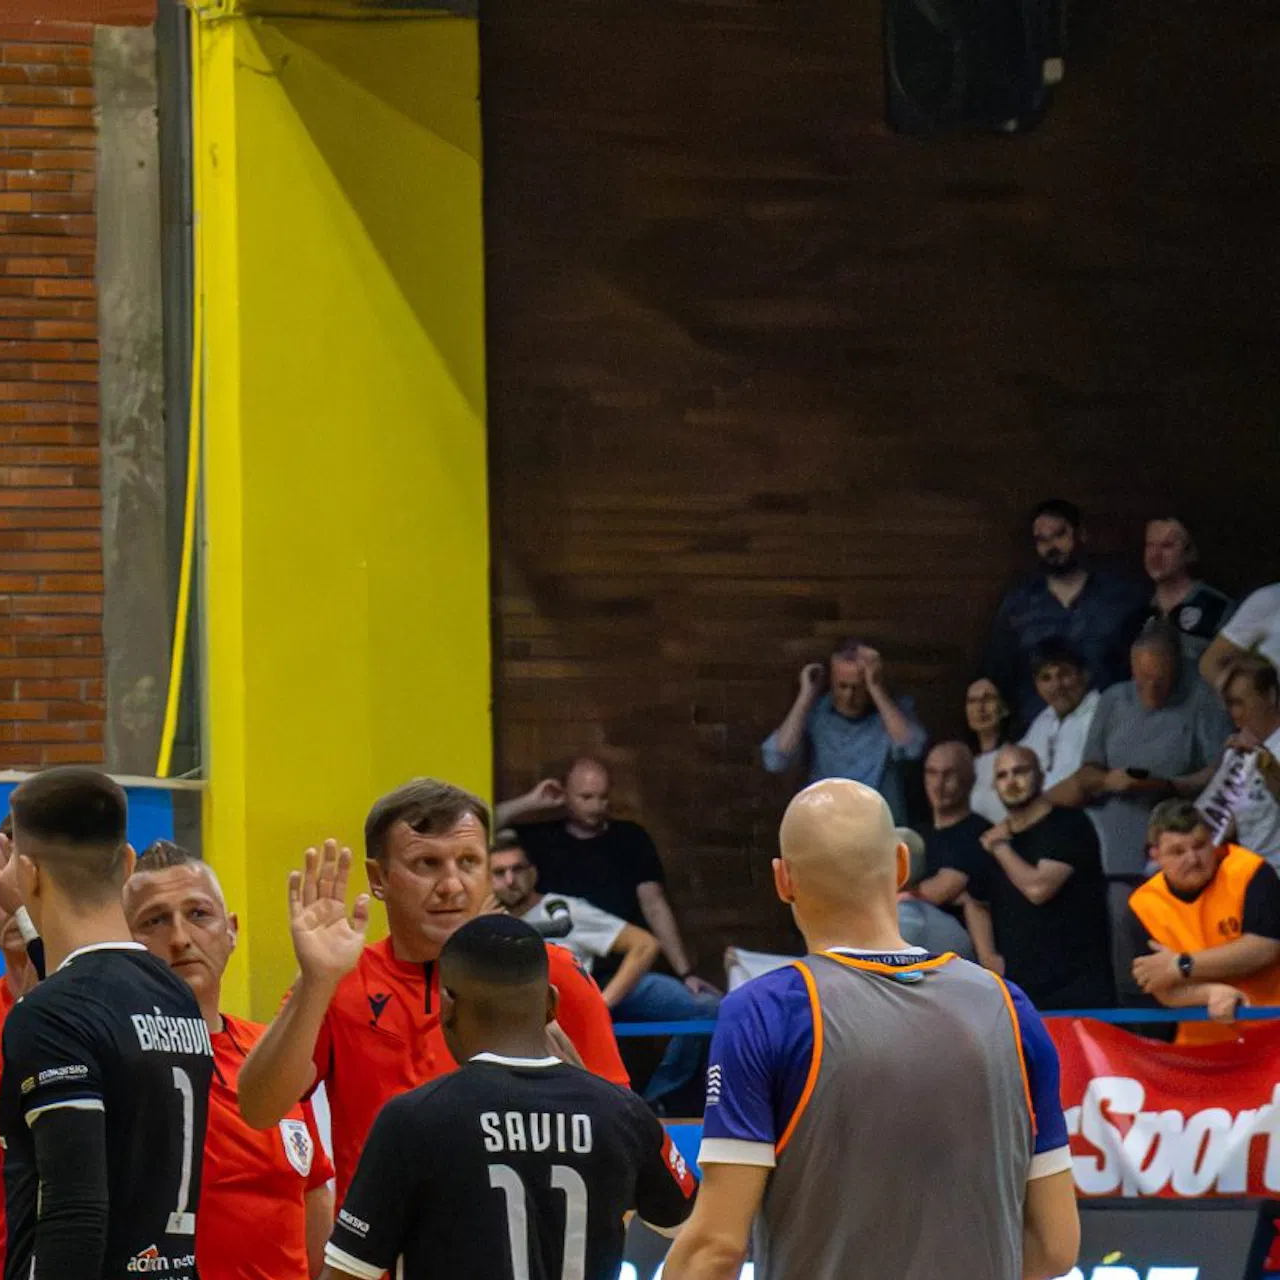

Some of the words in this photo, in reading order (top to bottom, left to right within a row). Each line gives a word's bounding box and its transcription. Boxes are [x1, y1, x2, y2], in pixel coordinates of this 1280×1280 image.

[130, 1005, 214, 1057] BAŠKOVI
[166, 1066, 197, 1235] 1
[480, 1111, 592, 1154] SAVIO
